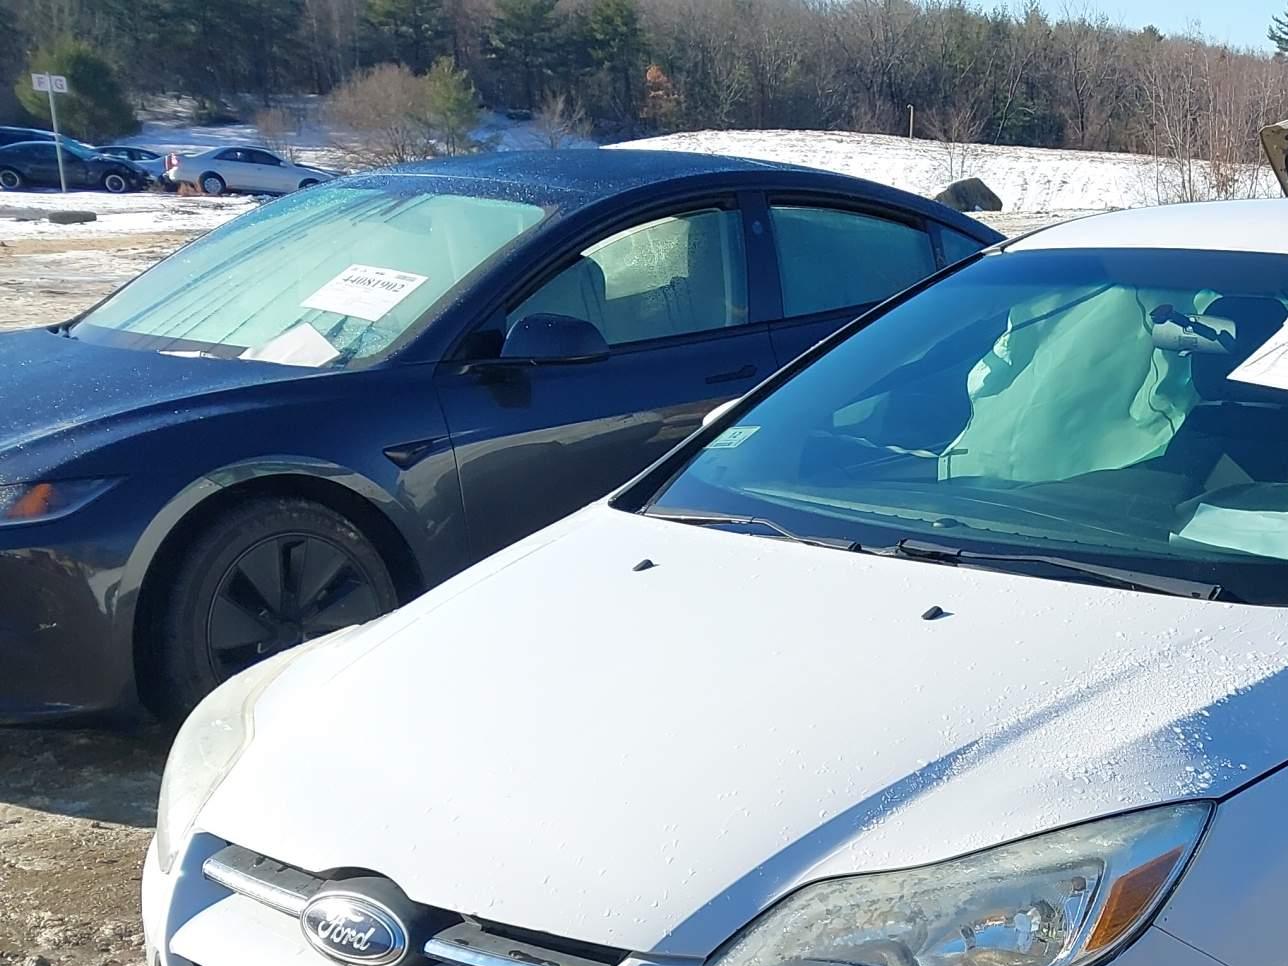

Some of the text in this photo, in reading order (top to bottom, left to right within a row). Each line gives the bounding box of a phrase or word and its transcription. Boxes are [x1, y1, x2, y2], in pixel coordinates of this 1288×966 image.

[54, 79, 65, 90] G
[343, 275, 405, 292] 44081902
[317, 910, 376, 951] Ford
